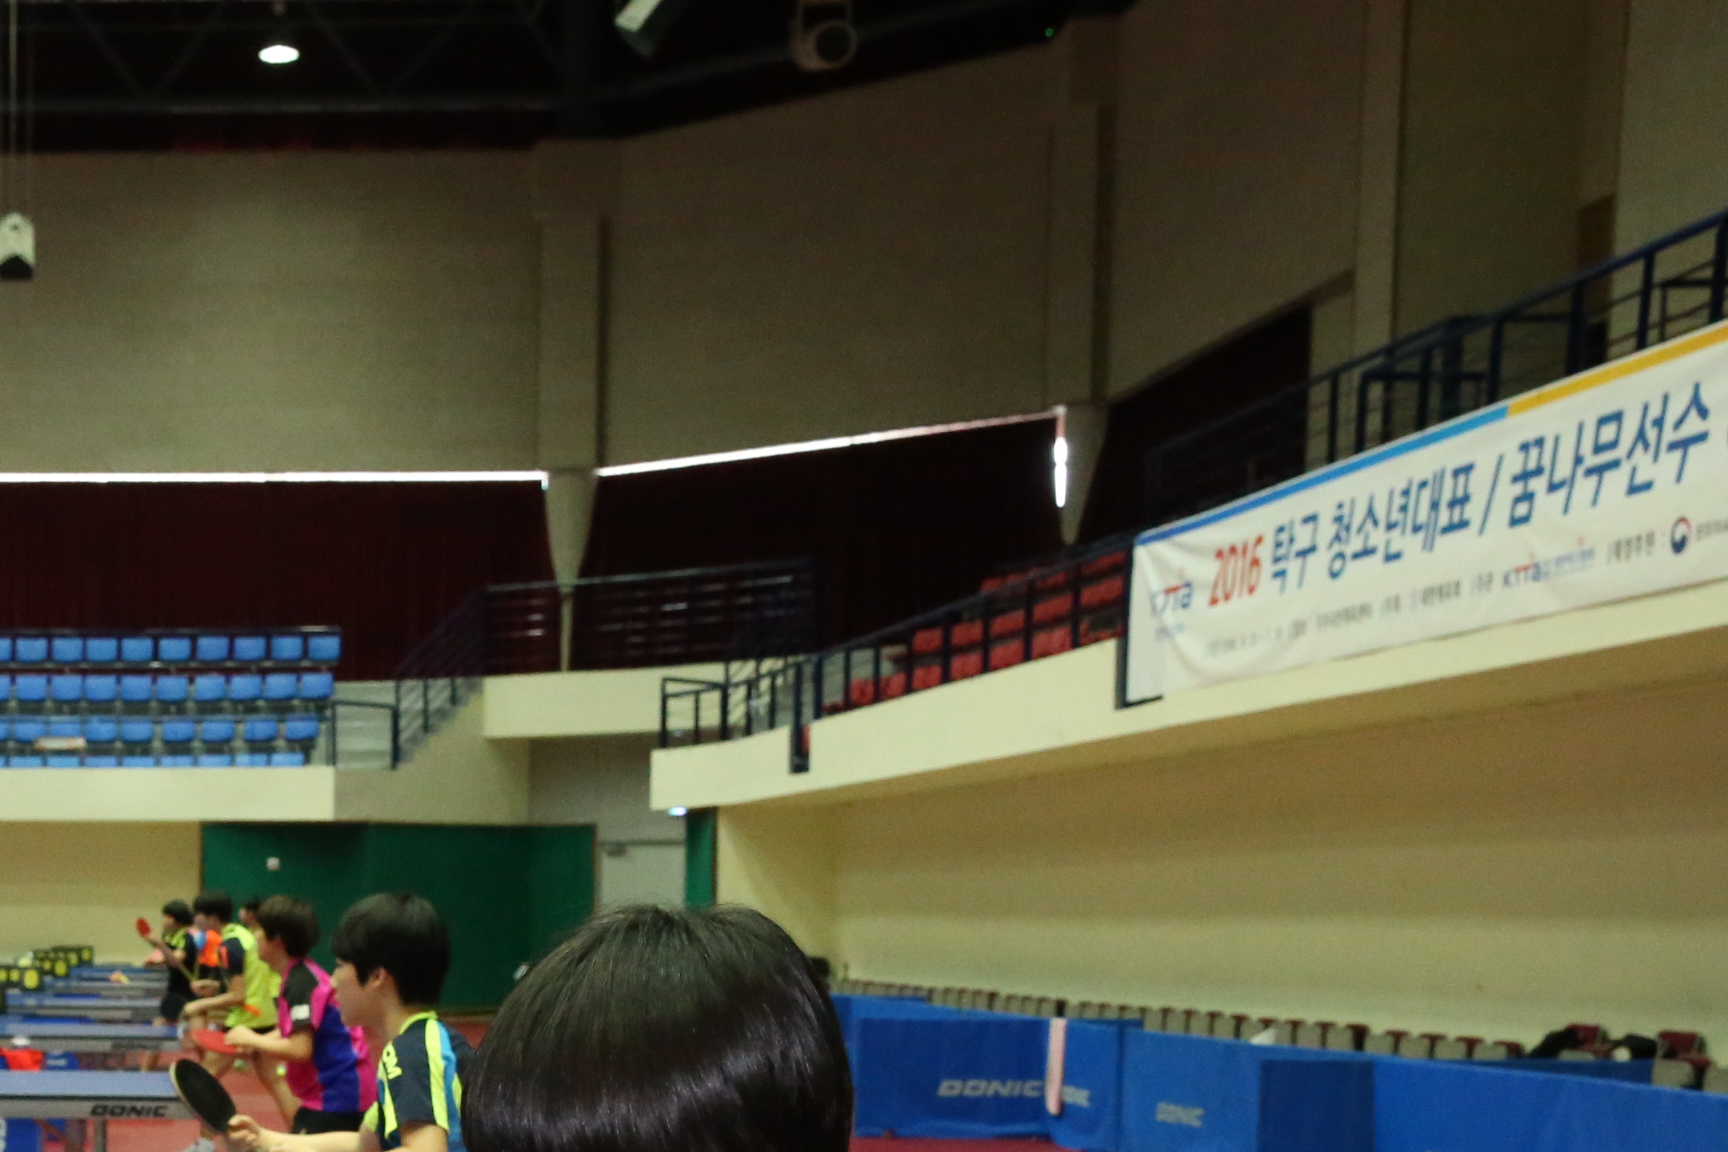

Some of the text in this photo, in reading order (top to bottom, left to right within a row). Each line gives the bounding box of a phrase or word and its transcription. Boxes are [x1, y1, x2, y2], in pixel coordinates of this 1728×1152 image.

[1208, 534, 1264, 607] 2016
[1271, 511, 1320, 595] 탁구
[1327, 461, 1476, 580] 청소년대표
[1508, 382, 1711, 529] 꿈나무선수
[937, 1079, 1044, 1098] DONIC
[90, 1104, 168, 1117] DONIC
